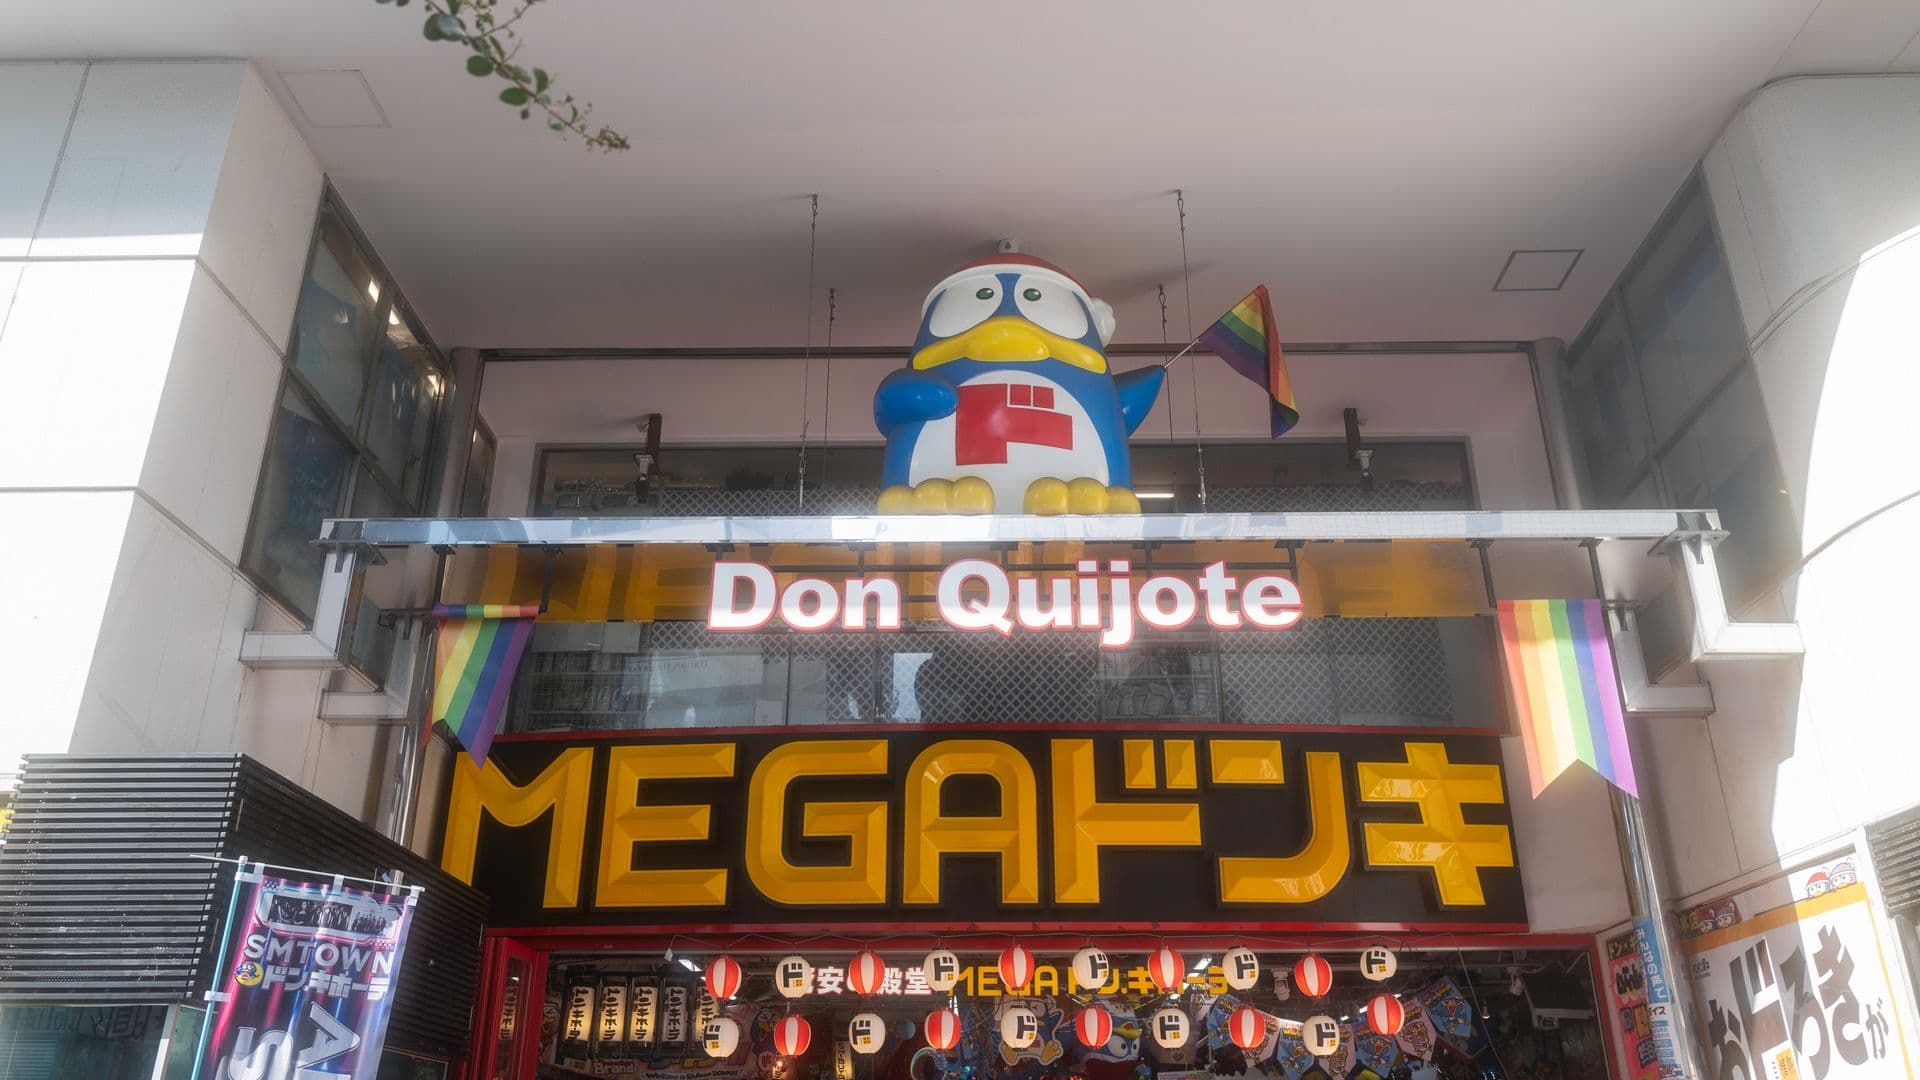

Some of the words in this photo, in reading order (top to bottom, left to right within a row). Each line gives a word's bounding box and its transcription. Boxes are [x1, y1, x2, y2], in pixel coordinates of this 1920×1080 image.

[956, 384, 1073, 466] ド
[708, 560, 901, 632] Don
[937, 558, 1304, 648] Quijote
[243, 933, 395, 974] SMTOWN
[807, 966, 932, 995] 安殿堂
